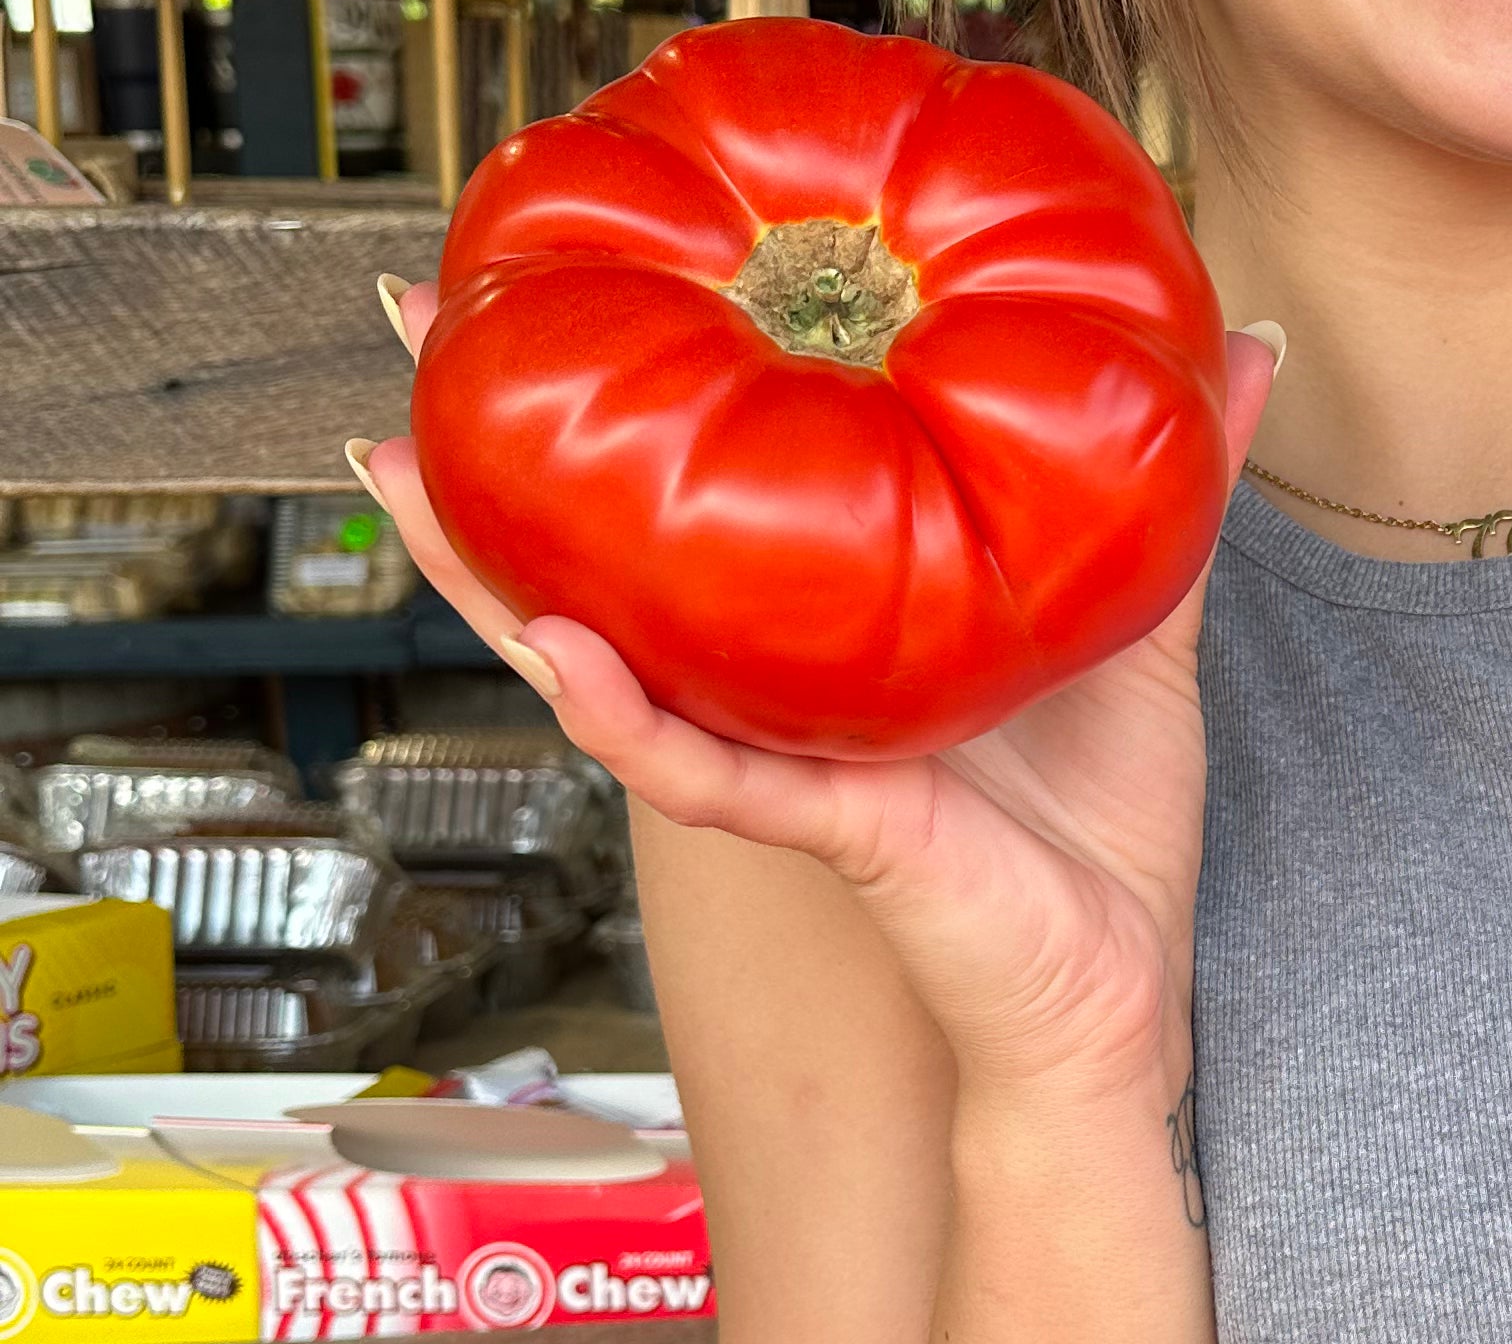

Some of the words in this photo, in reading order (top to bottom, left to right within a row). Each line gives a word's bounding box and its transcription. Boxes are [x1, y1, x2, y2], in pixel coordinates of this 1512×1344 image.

[41, 1264, 193, 1317] Chew
[274, 1262, 460, 1315] French
[556, 1261, 711, 1315] Chew
